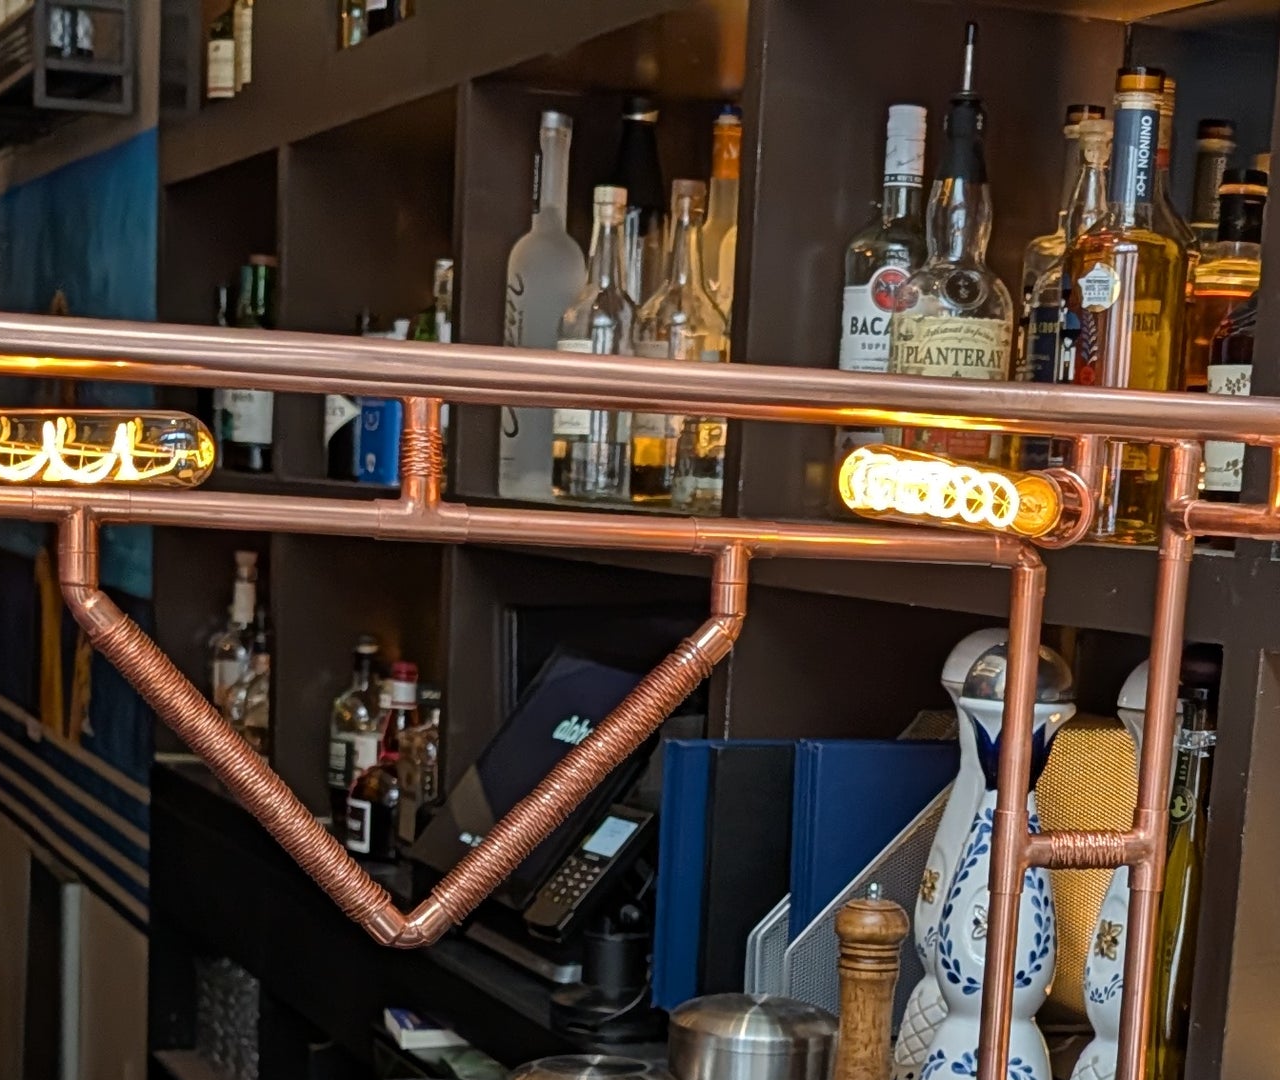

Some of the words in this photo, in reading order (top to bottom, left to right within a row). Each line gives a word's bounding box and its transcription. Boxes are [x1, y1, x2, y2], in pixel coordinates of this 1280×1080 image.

[1138, 115, 1153, 169] NONINO
[849, 316, 892, 336] BACA
[905, 345, 1004, 369] PLANTERAY
